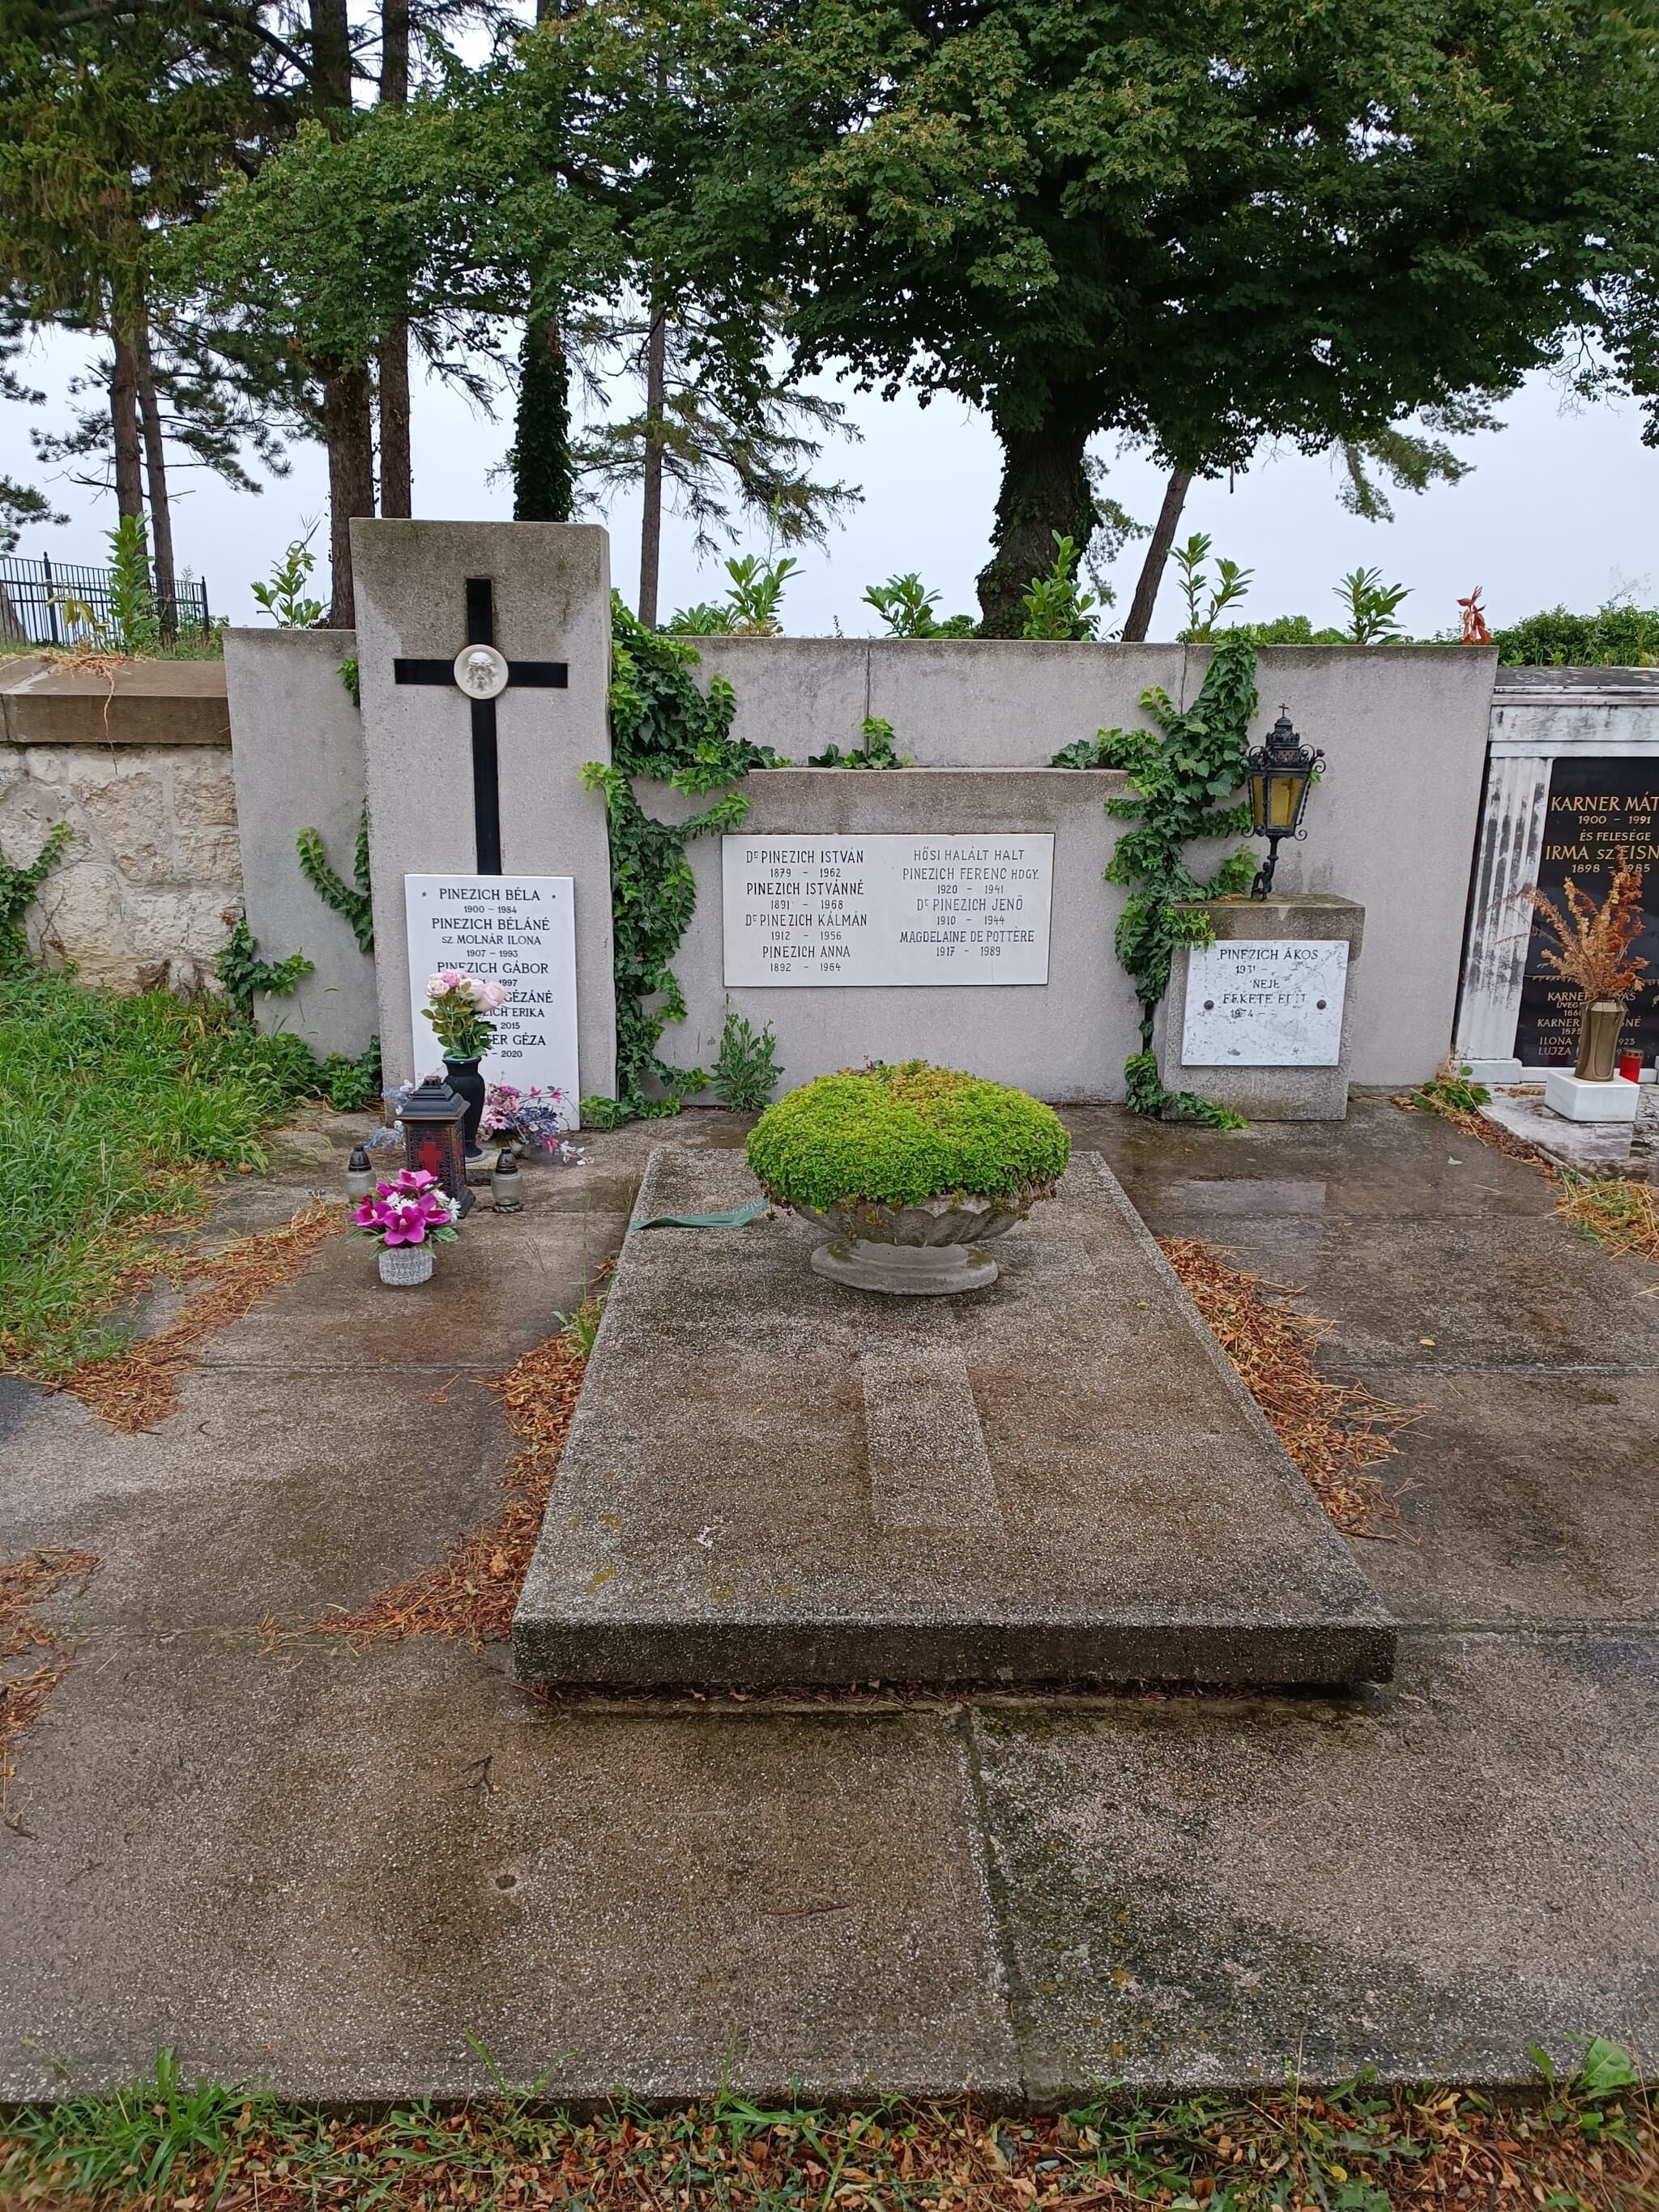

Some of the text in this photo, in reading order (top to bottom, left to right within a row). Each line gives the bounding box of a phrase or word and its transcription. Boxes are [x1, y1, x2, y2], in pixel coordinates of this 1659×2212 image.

[1550, 796, 1620, 811] KARNER
[1578, 816, 1606, 825] 1900
[1628, 816, 1651, 825] 1991
[1580, 829, 1651, 842] ÉS FELESÉGE
[761, 850, 814, 863] PINEZICH
[821, 846, 864, 863] ISTVÁN
[914, 846, 1025, 861] HŐSI HALÁLT HALT
[1546, 845, 1589, 860] IRMA
[770, 868, 791, 878] 1879
[821, 867, 842, 878] 1962
[902, 867, 954, 880] PINEZICH
[960, 867, 1007, 880] FERENC
[1572, 864, 1600, 873] 1898
[1627, 863, 1651, 873] 985
[747, 879, 864, 895] PINEZICH ISTVÁNNÉ
[937, 884, 957, 894] 1920
[985, 884, 1004, 894] 1941
[439, 886, 540, 901] PINEZICH BÉLA
[464, 905, 484, 914] 1900
[497, 906, 517, 914] 1984
[771, 900, 790, 910] 1891
[821, 900, 843, 910] 1968
[933, 898, 986, 911] PINEZICH
[432, 916, 550, 931] PINEZICH BÉLÁNÉ
[760, 914, 812, 927] PINEZICH
[818, 911, 867, 927] KÁLMÁN
[937, 915, 956, 925] 1910
[984, 915, 1004, 925] 1944
[457, 933, 504, 945] MOLNÁR
[508, 936, 541, 945] ILONA
[771, 931, 791, 940] 1912
[821, 931, 842, 940] 1956
[900, 931, 966, 943] MAGDELAINE
[970, 931, 983, 942] DE
[467, 949, 486, 957] 1907
[499, 950, 518, 958] 1993
[762, 946, 850, 958] PINEZICH ANNA
[936, 947, 955, 957] 1917
[980, 946, 1001, 957] 1989
[1220, 947, 1318, 960] PINEZICH ÁKOS
[437, 960, 549, 974] PINEZICH GÁBOR
[770, 963, 791, 972] 1892
[821, 962, 842, 972] 1964
[503, 989, 553, 1004] GÉZÁNÉ
[512, 1008, 545, 1017] ERIKA
[501, 1021, 520, 1029] 2015
[1537, 1018, 1580, 1027] KARNER
[513, 1032, 546, 1046] GÉZA
[1540, 1037, 1572, 1045] ILONA
[501, 1050, 522, 1058] 2020
[1538, 1046, 1572, 1055] LUJZA
